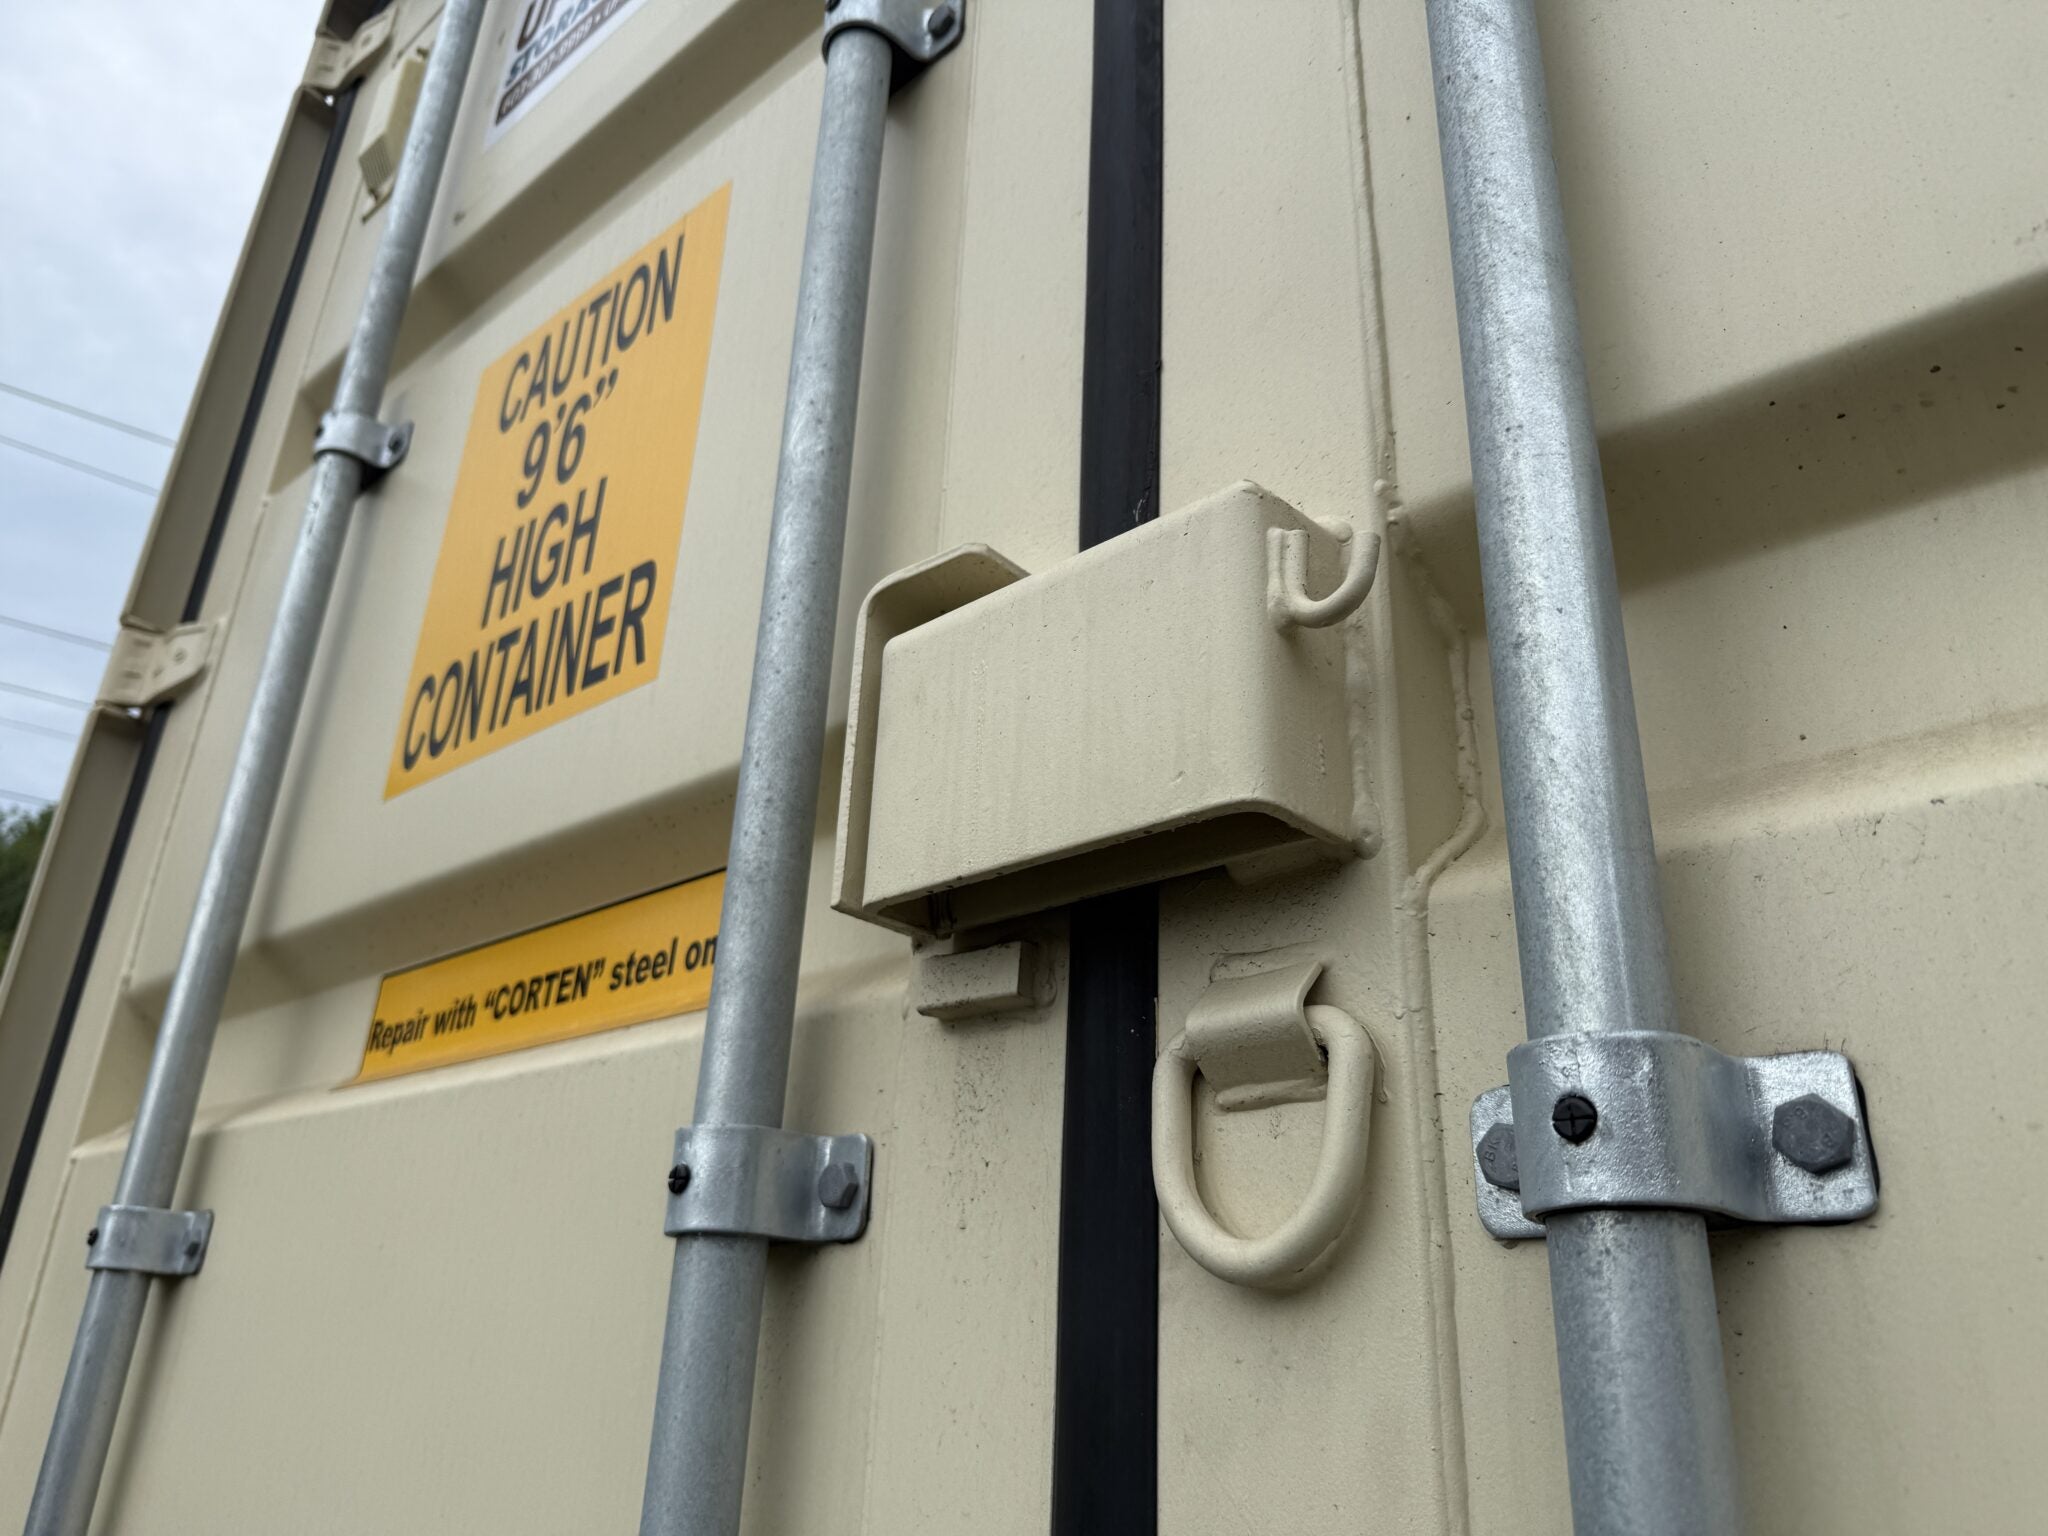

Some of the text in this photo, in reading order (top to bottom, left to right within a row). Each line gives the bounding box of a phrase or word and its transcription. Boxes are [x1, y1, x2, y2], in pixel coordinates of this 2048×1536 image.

[499, 234, 685, 434] CAUTION
[480, 476, 609, 630] HIGH
[402, 558, 658, 772] CONTAINER
[368, 1008, 431, 1056] Repair
[433, 994, 477, 1036] with
[608, 936, 679, 993] steel
